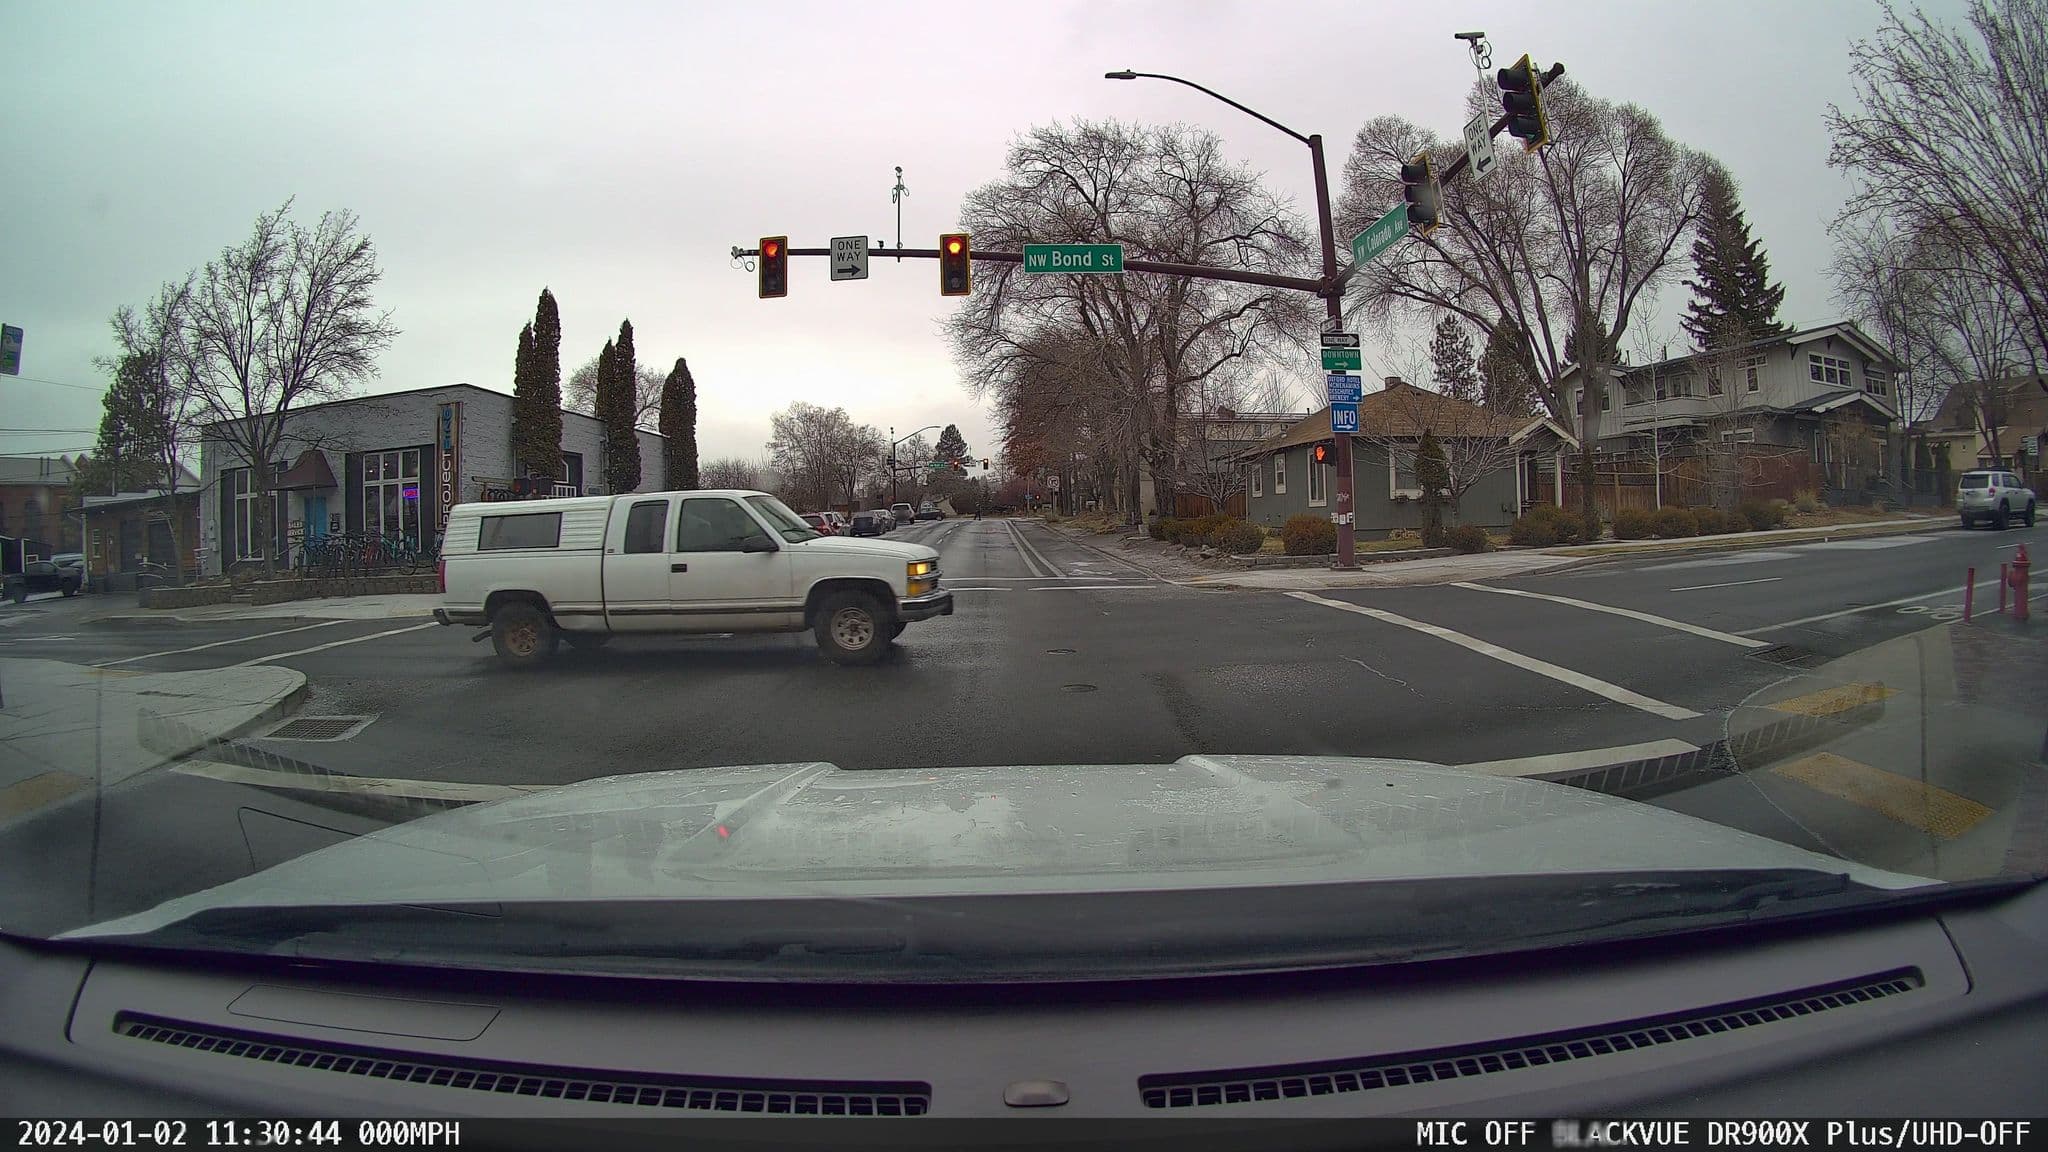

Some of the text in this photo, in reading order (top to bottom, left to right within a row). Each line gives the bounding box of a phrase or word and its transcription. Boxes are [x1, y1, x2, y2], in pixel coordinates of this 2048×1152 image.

[1468, 119, 1484, 141] ONE
[1470, 133, 1487, 156] WAY
[837, 239, 861, 251] ONE
[1366, 223, 1392, 253] Colorado
[836, 251, 862, 262] WAY
[1028, 250, 1115, 267] NW Bond St
[1322, 350, 1360, 359] DOWNTOWN
[1333, 410, 1356, 425] INFO
[442, 450, 452, 525] PROJECT
